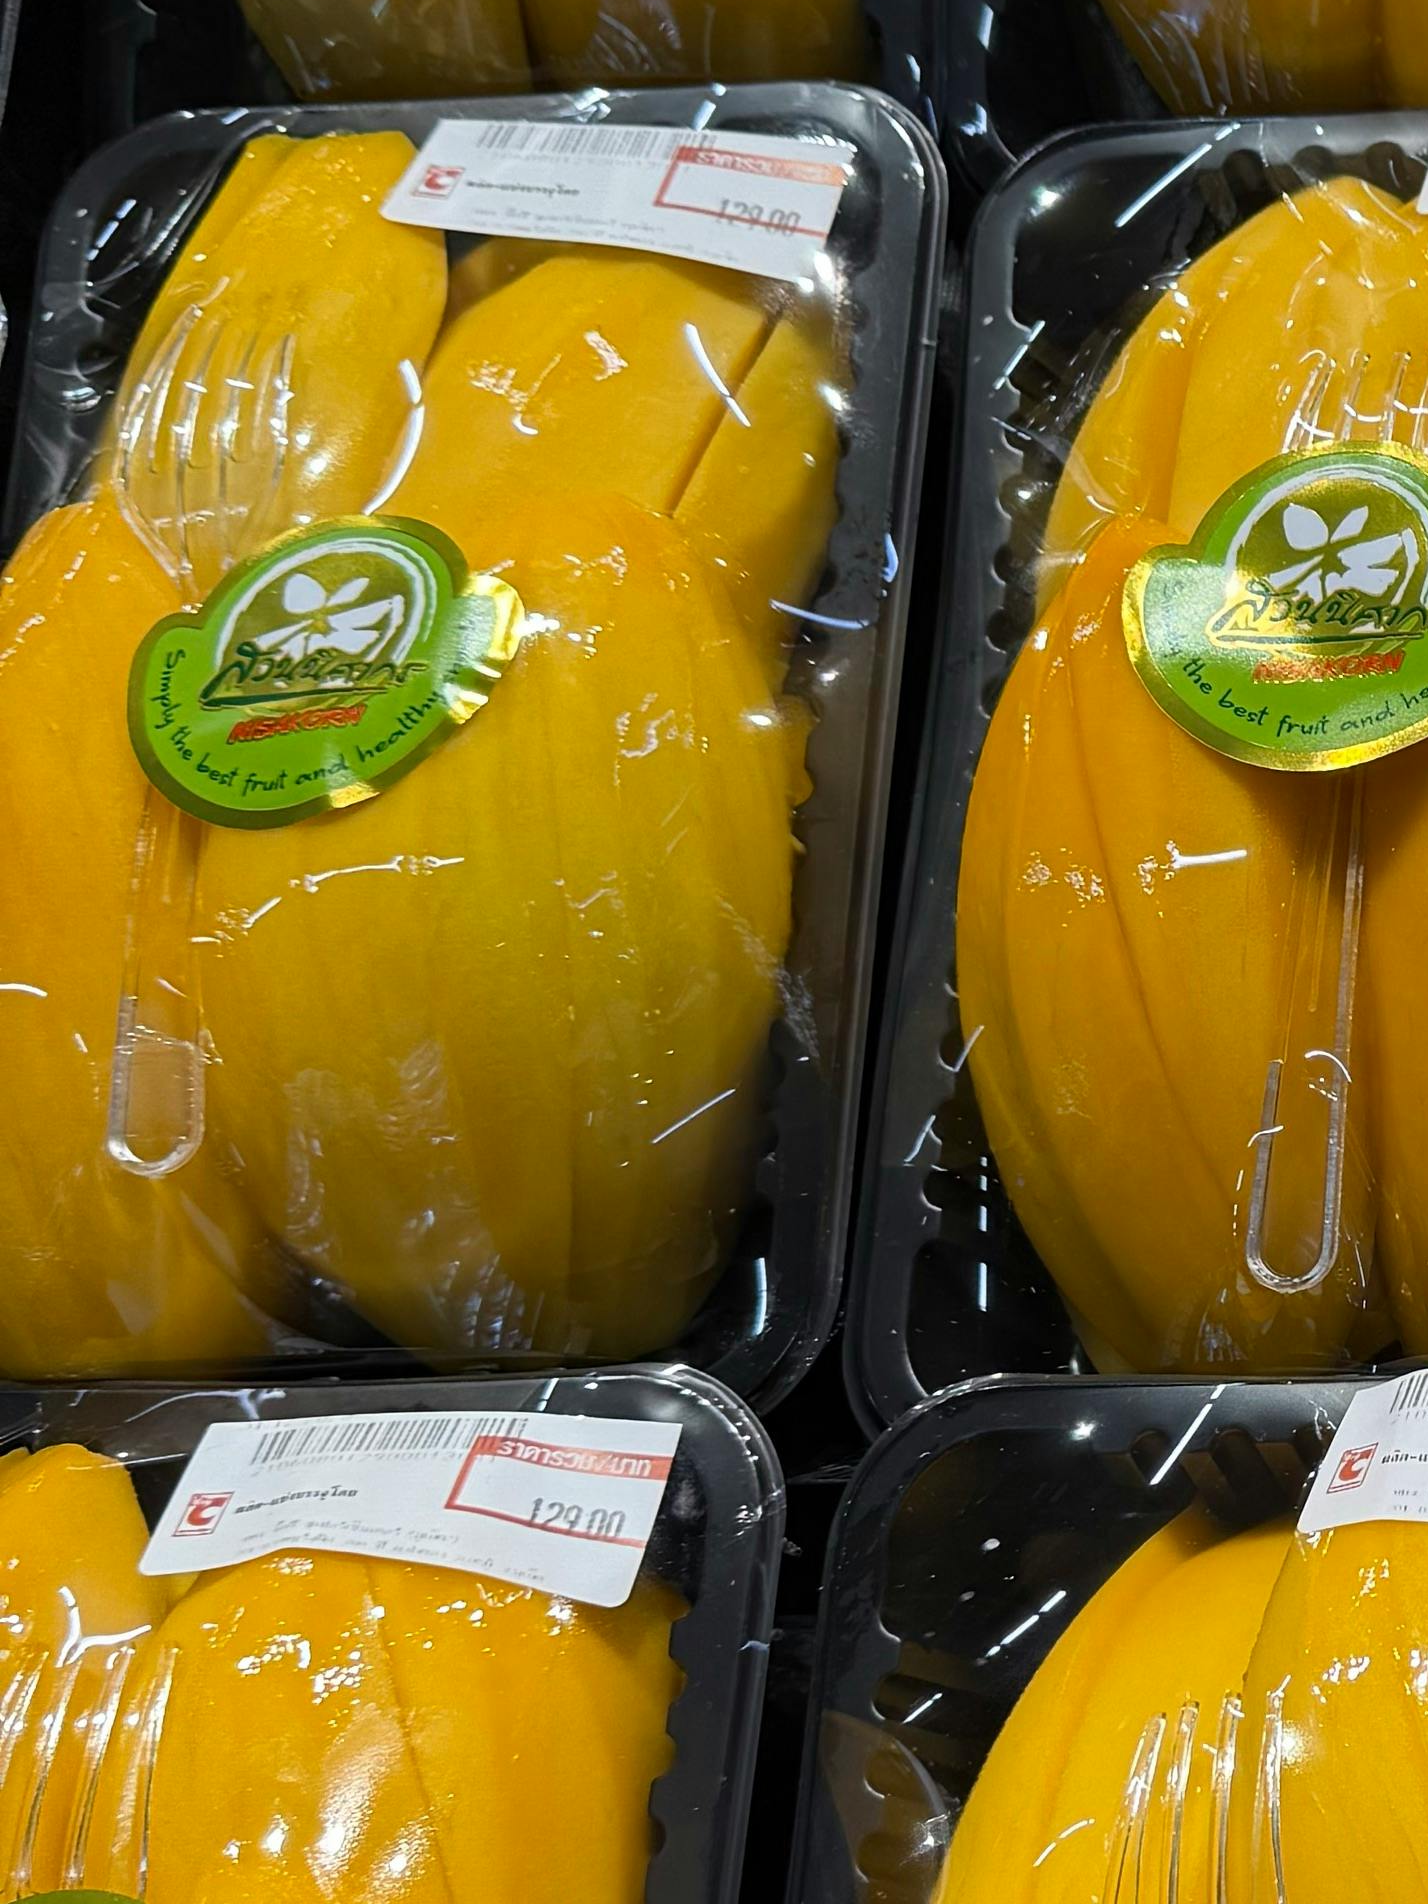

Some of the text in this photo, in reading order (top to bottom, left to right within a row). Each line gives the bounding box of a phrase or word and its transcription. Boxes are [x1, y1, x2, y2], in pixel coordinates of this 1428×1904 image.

[716, 197, 801, 238] 129.00
[1184, 658, 1212, 694] the
[1219, 692, 1269, 726] best
[1276, 717, 1330, 737] fruit
[1341, 701, 1395, 731] and
[151, 651, 186, 729] Simply
[172, 726, 192, 761] the
[196, 757, 238, 788] best
[240, 772, 289, 796] fruit
[296, 754, 347, 785] and
[230, 704, 368, 744] NISAKORN
[498, 1439, 653, 1478] ราคารวม/บาท
[530, 1496, 627, 1538] 129.00
